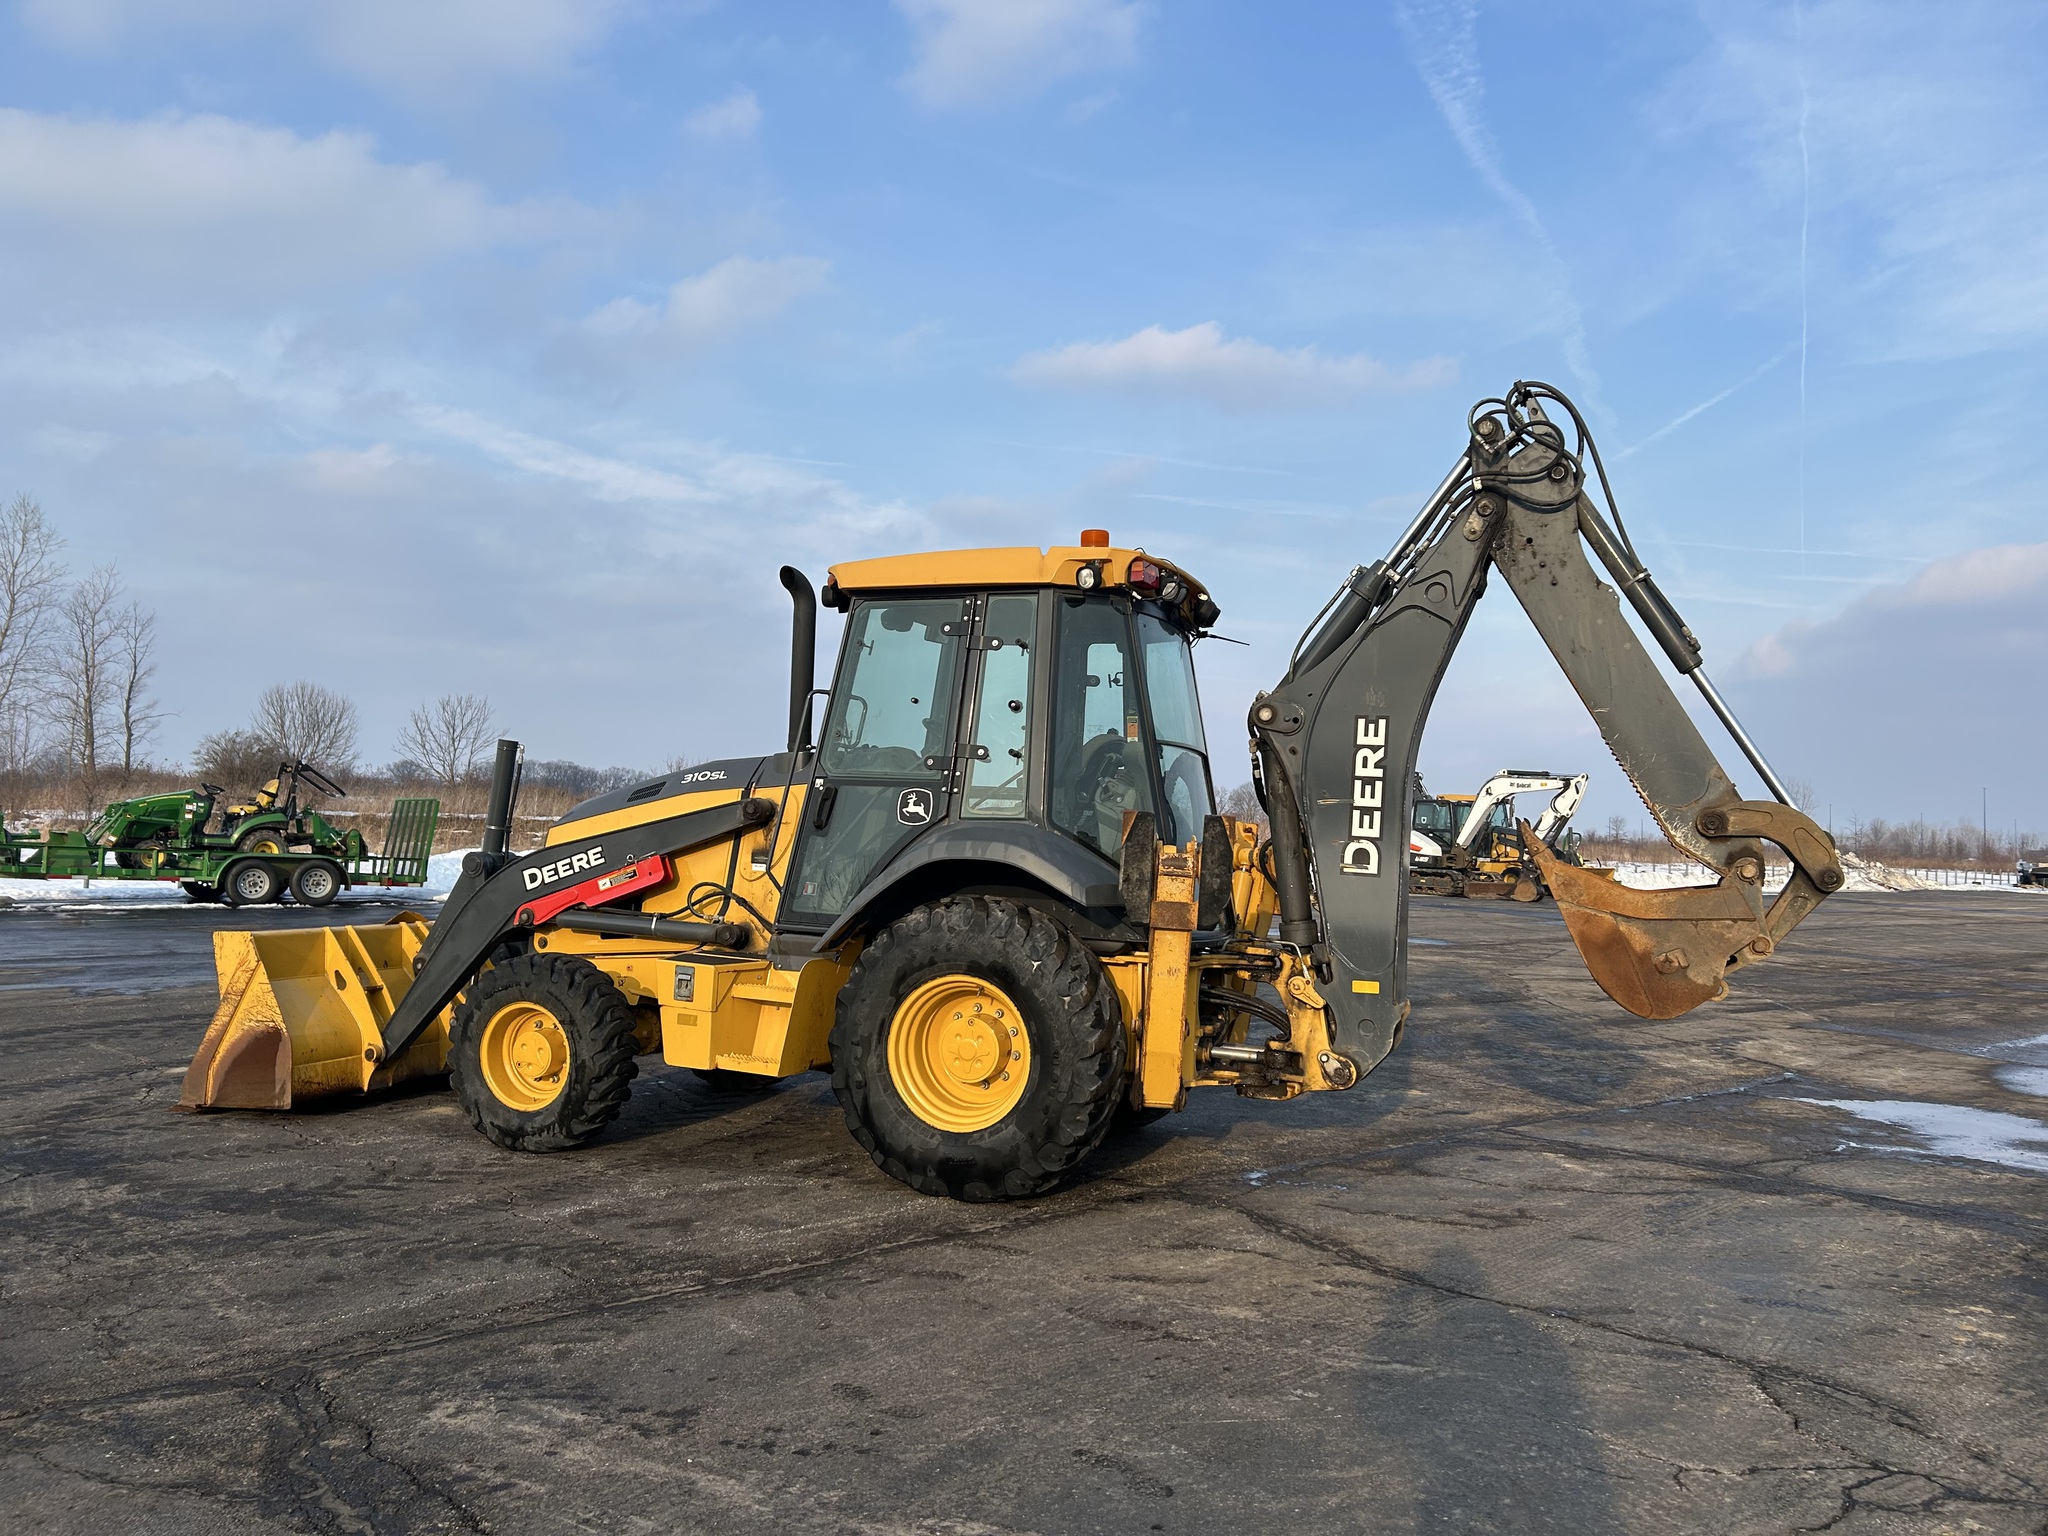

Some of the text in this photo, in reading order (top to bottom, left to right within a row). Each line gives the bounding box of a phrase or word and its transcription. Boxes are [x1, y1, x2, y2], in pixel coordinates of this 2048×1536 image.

[681, 771, 727, 783] 310SL
[1343, 718, 1386, 874] DEERE
[523, 846, 605, 890] DEERE
